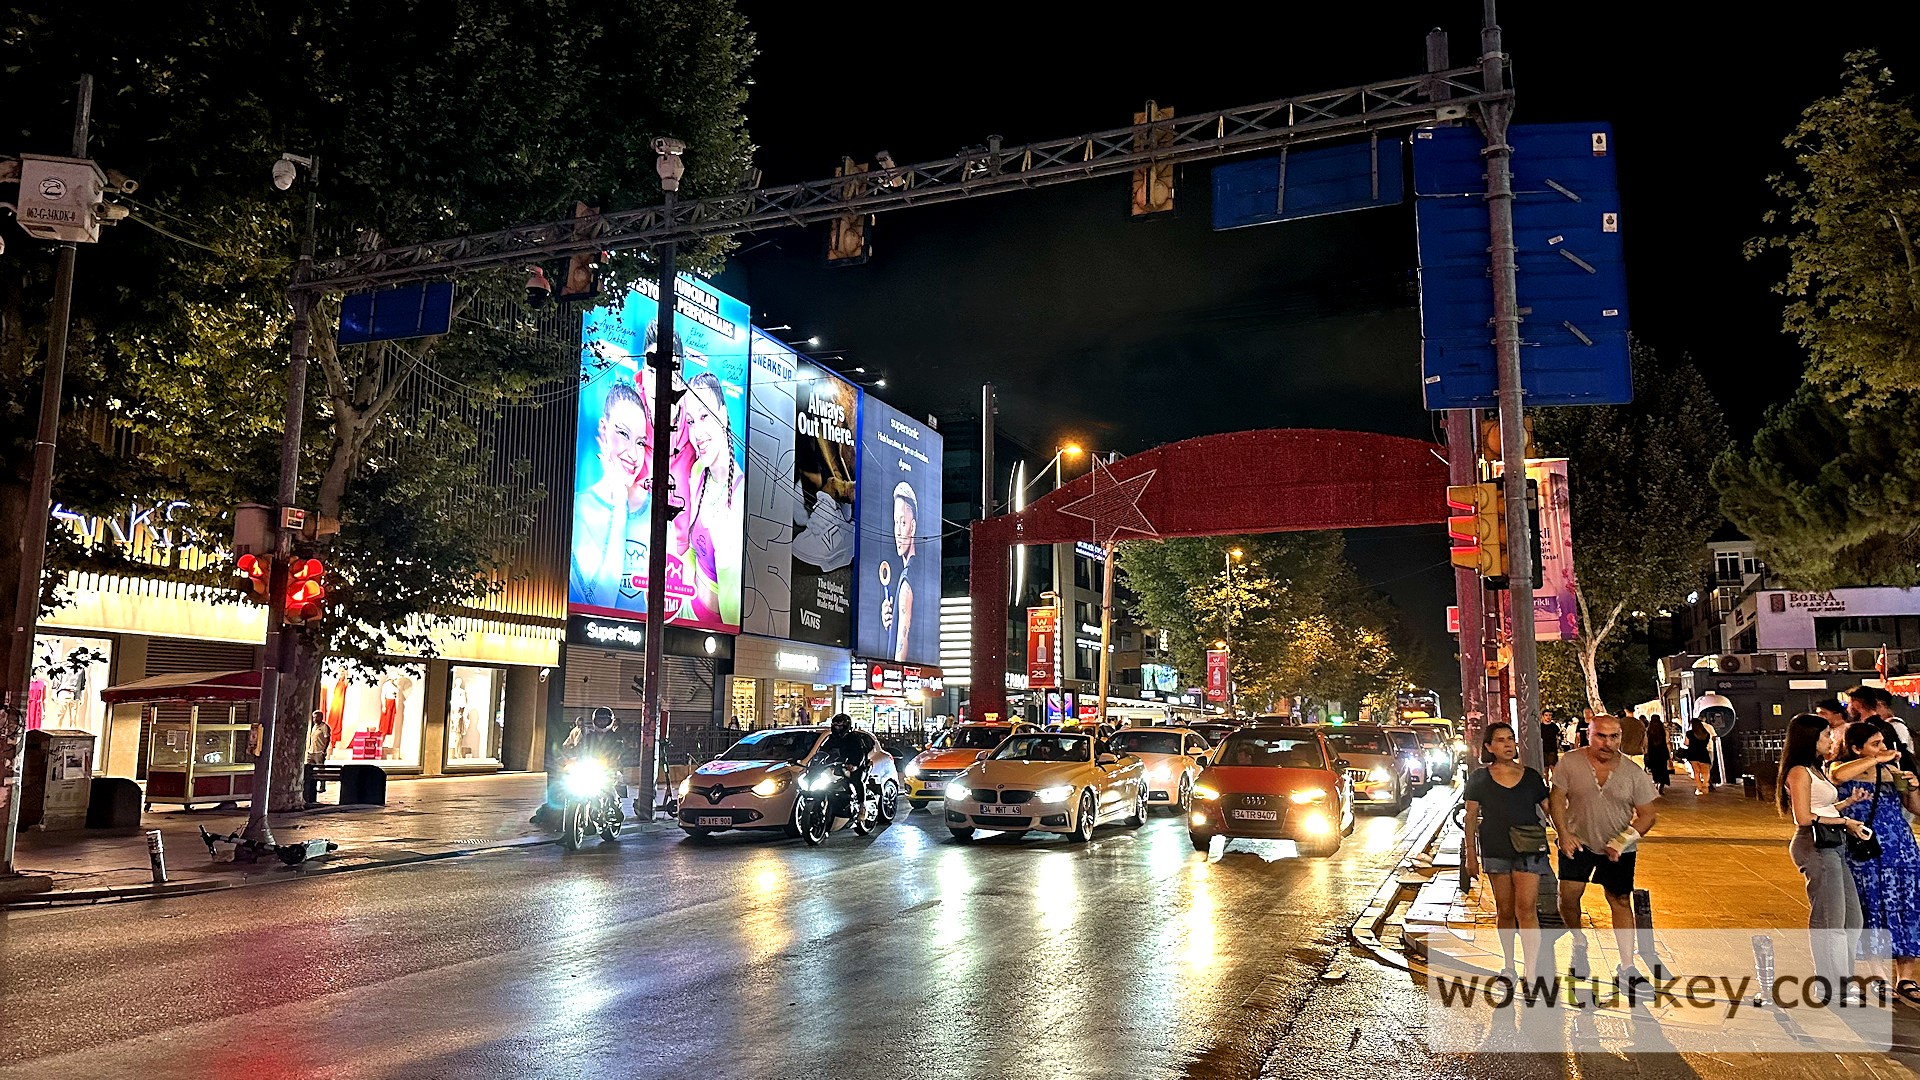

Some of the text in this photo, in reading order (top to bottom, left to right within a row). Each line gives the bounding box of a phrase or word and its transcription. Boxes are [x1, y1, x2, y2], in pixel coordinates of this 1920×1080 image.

[752, 354, 792, 382] SNEAKS UP
[808, 392, 845, 422] Always
[798, 412, 854, 447] Out There.
[890, 418, 920, 440] supersonic
[818, 578, 826, 589] The
[1533, 598, 1550, 606] rikli
[800, 608, 821, 630] VANS
[1032, 670, 1046, 678] 29
